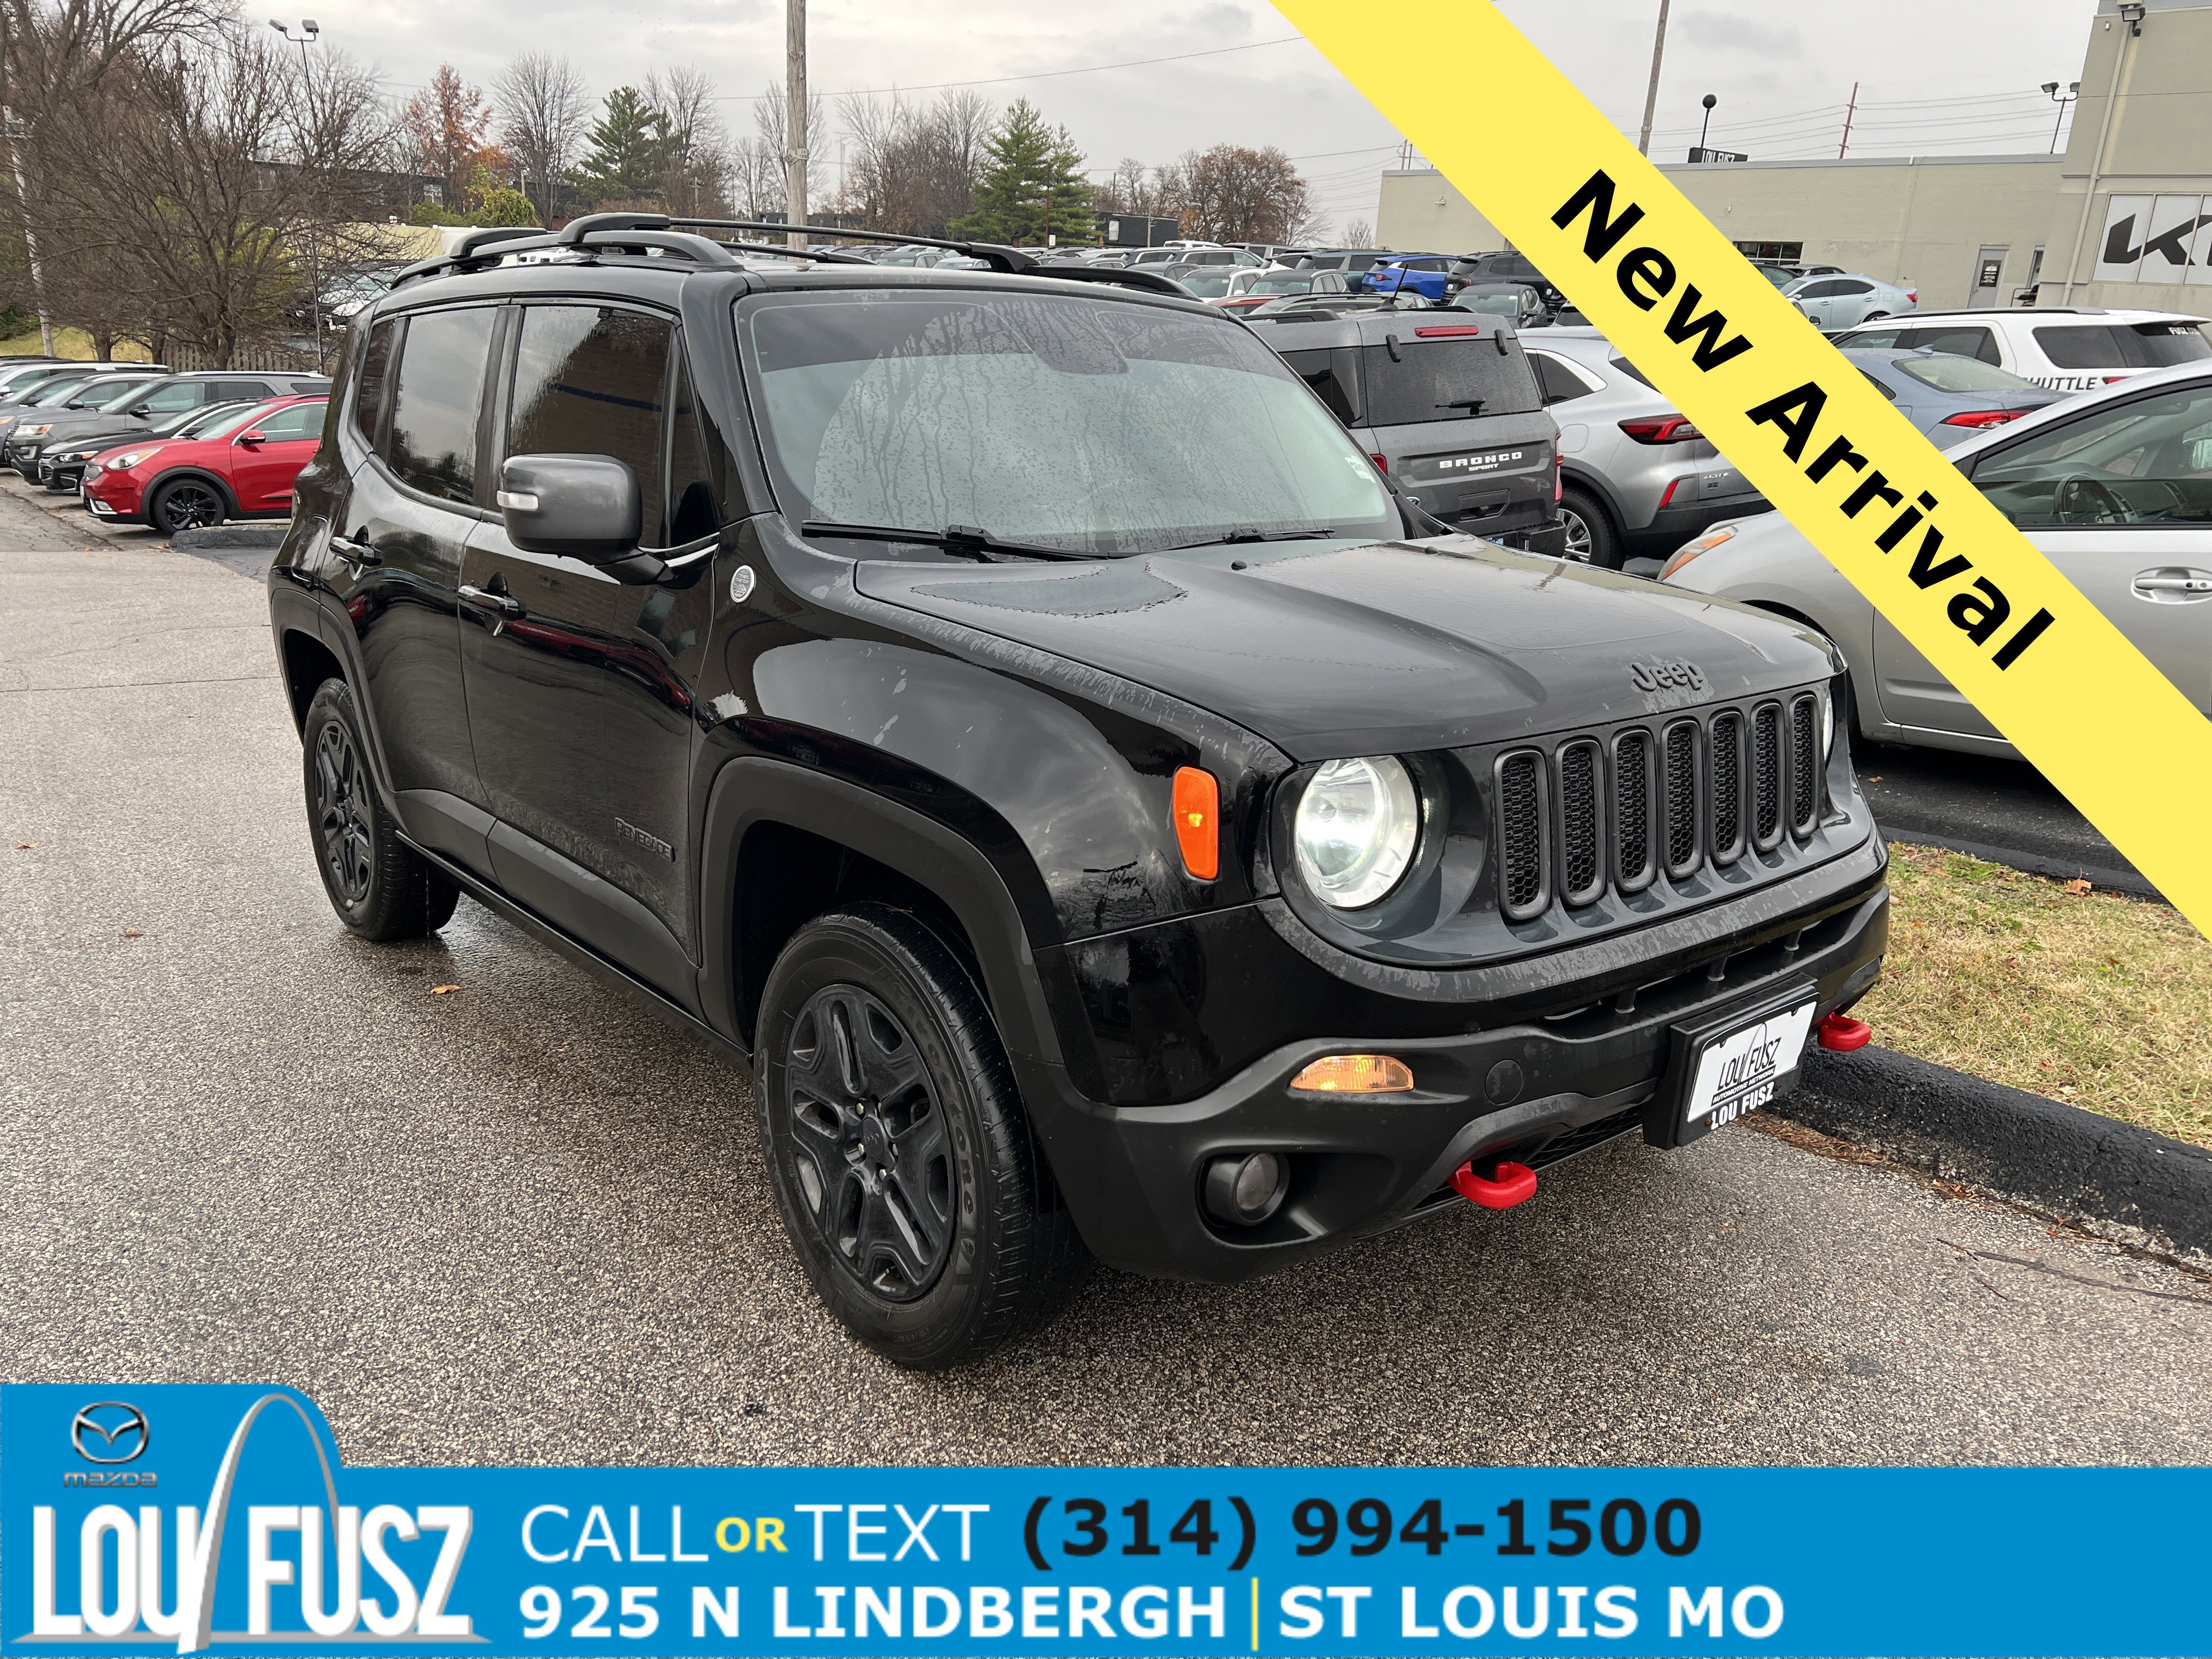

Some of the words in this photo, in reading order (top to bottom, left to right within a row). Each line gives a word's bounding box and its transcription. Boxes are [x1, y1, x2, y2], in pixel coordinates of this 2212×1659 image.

[2022, 377, 2098, 390] HUTTLE
[1440, 452, 1522, 469] BRONCO
[1469, 463, 1499, 471] SPORT
[1631, 662, 1703, 691] Jeep
[614, 817, 675, 863] RENEGADE
[1717, 1053, 1746, 1091] LOU
[1747, 1037, 1782, 1078] FUSZ
[1712, 1082, 1748, 1104] AUTOMOTIVE
[1748, 1069, 1774, 1086] NETWORK
[1711, 1100, 1738, 1130] LOU
[1741, 1081, 1775, 1115] FUSZ
